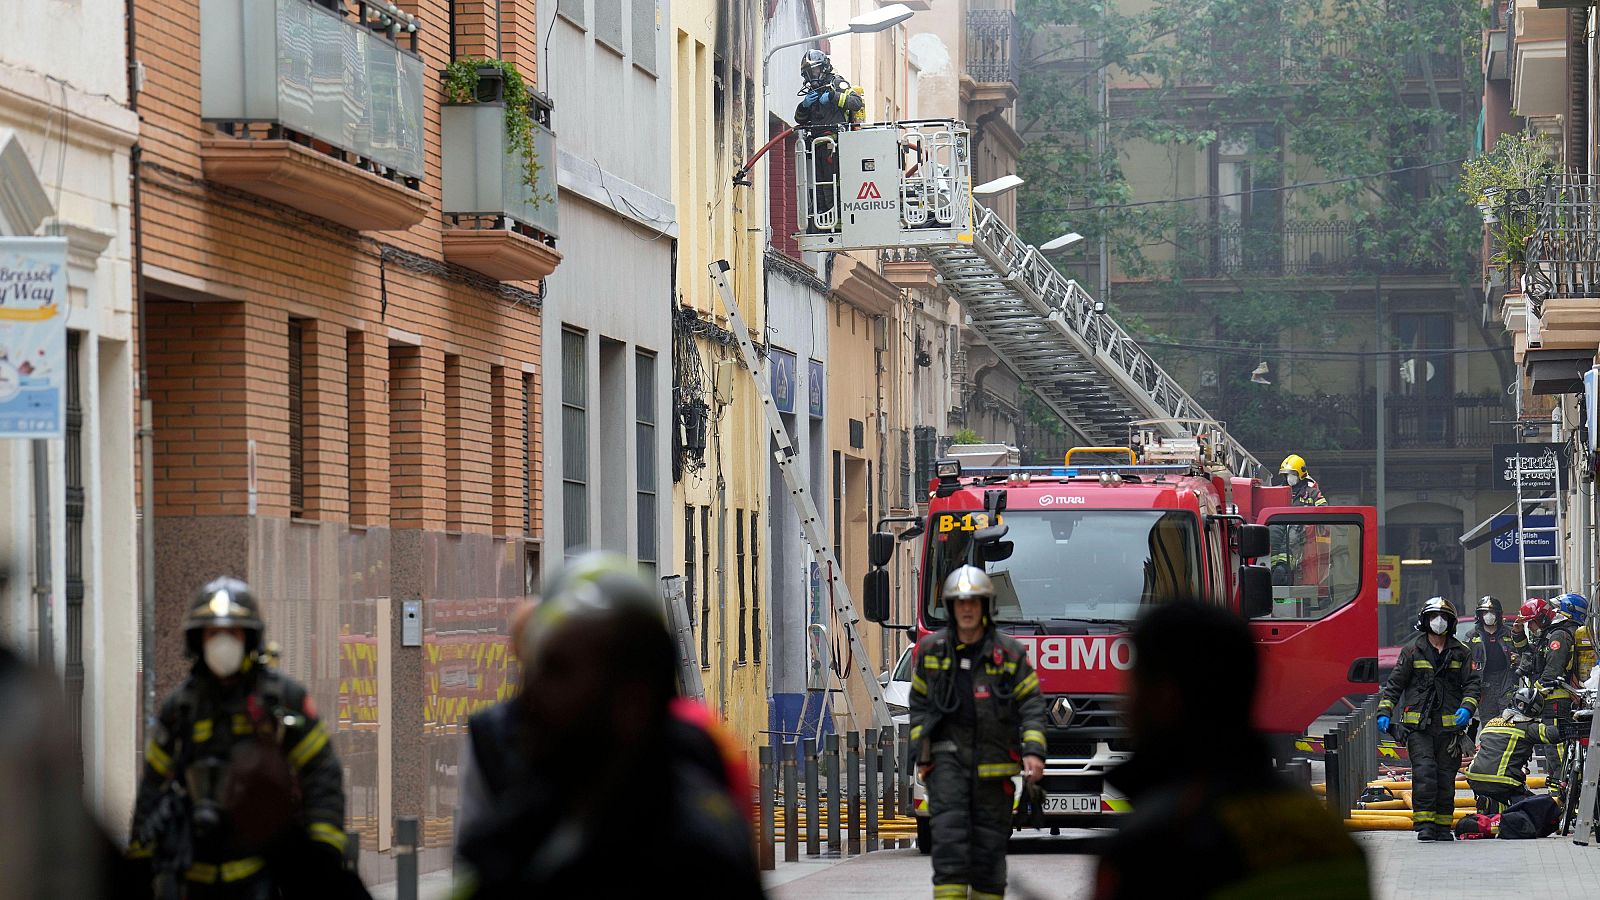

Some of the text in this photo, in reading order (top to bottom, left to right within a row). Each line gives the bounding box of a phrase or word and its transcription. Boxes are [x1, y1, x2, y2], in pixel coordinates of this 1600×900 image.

[843, 200, 896, 212] MAGIRUS
[9, 283, 54, 306] Way
[1504, 456, 1557, 470] TERRA
[1055, 496, 1085, 504] ITURRI
[1514, 532, 1538, 541] Eglish
[1072, 798, 1097, 810] LDW
